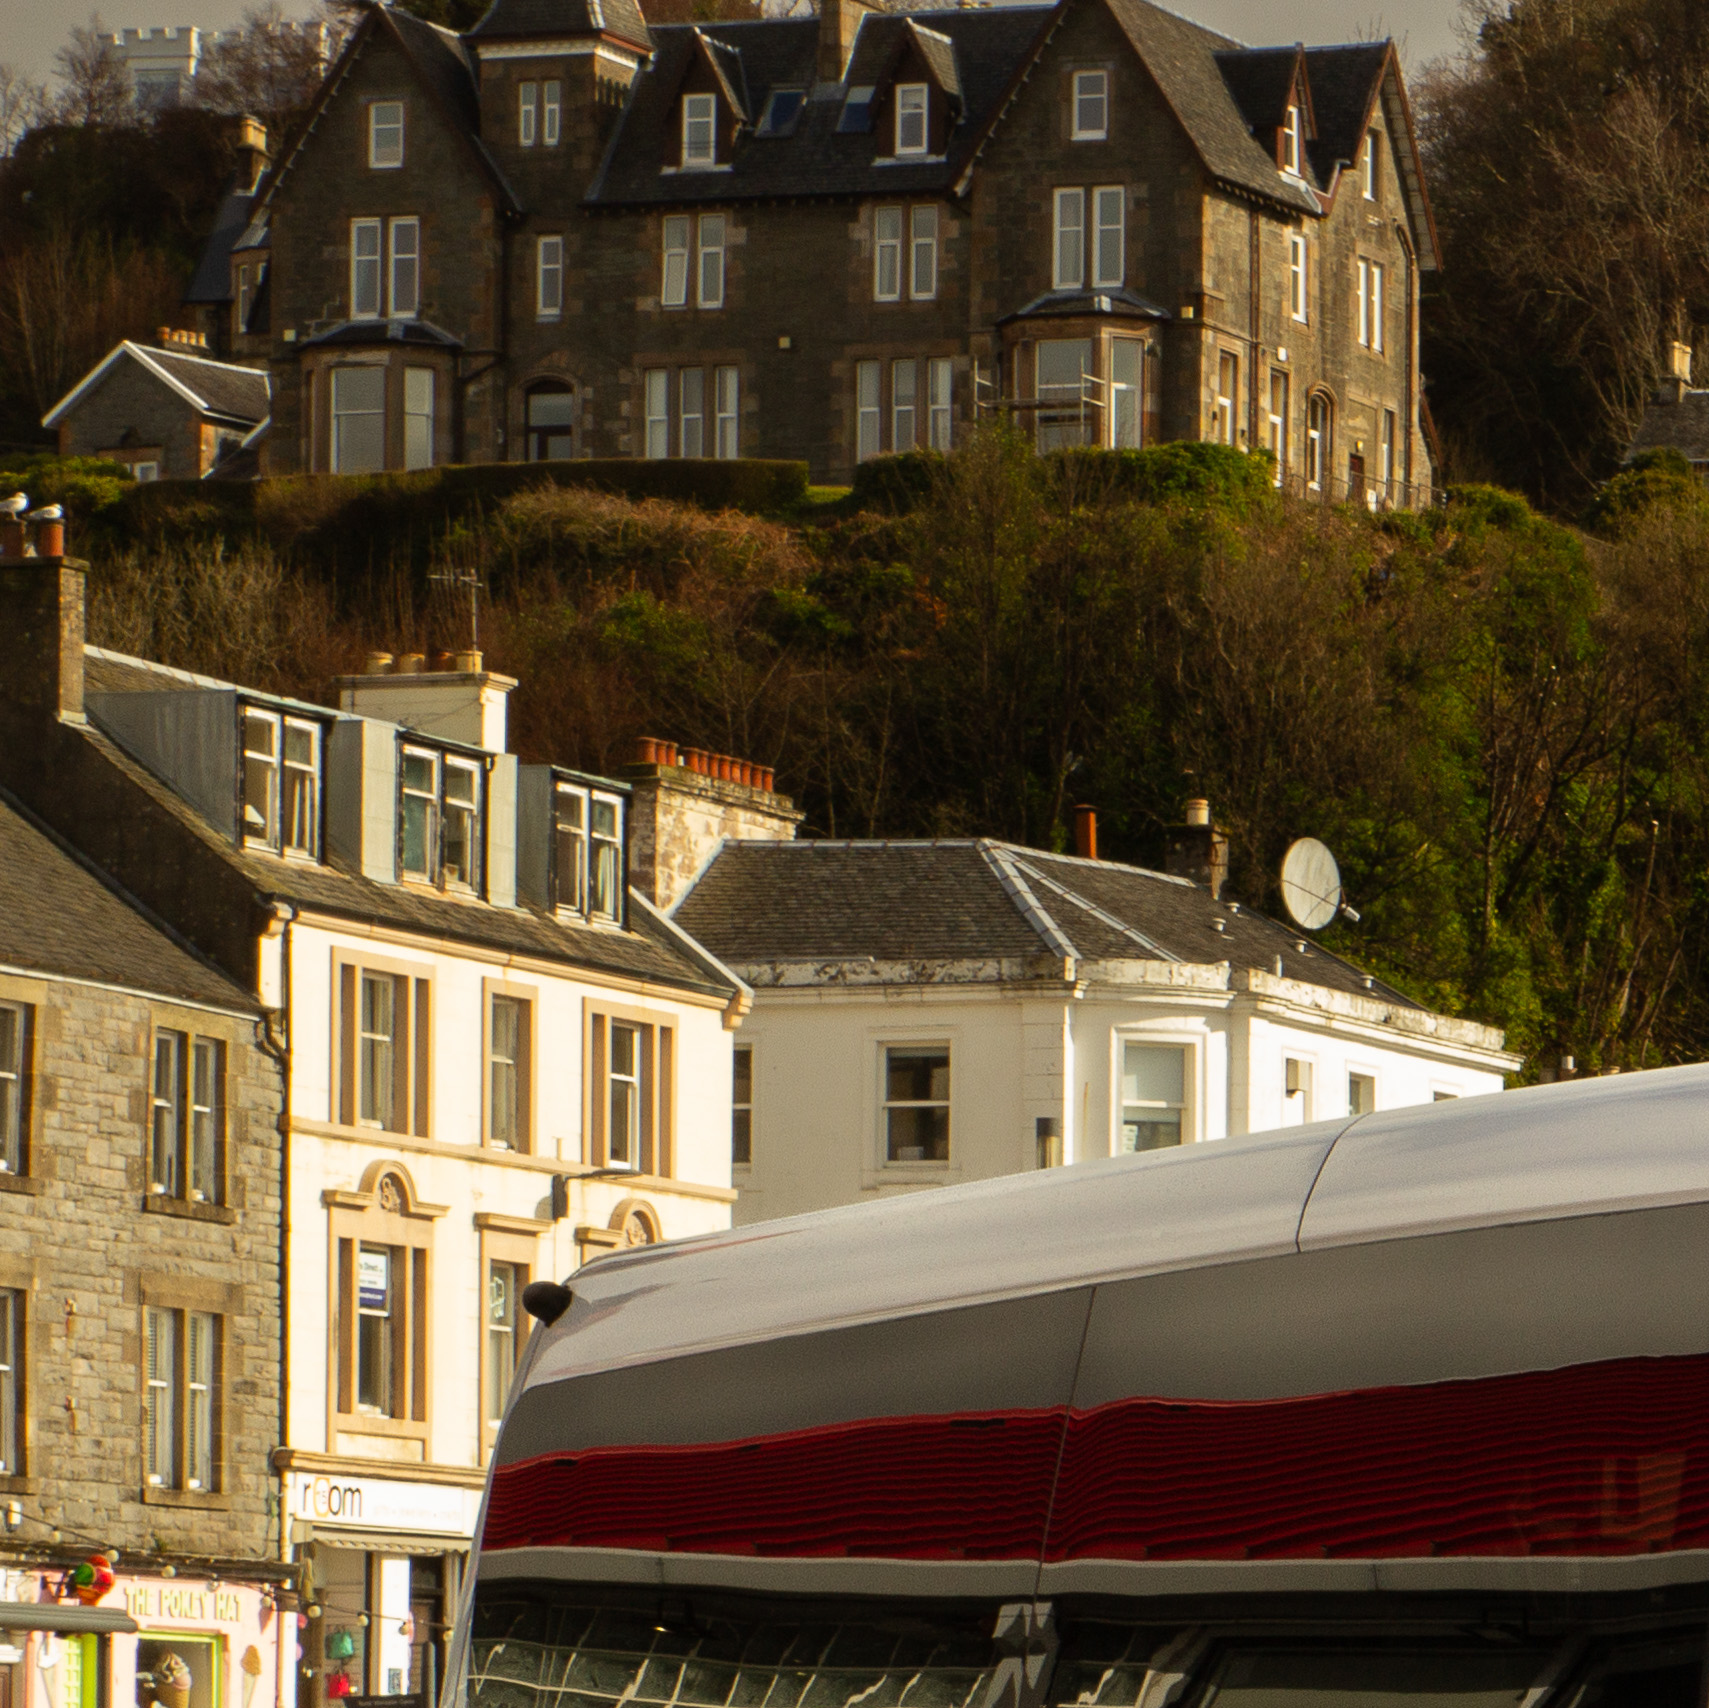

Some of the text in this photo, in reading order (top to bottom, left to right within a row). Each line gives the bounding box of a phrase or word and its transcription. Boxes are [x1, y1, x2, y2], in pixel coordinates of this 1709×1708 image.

[125, 1586, 241, 1622] THE POKEY HAT
